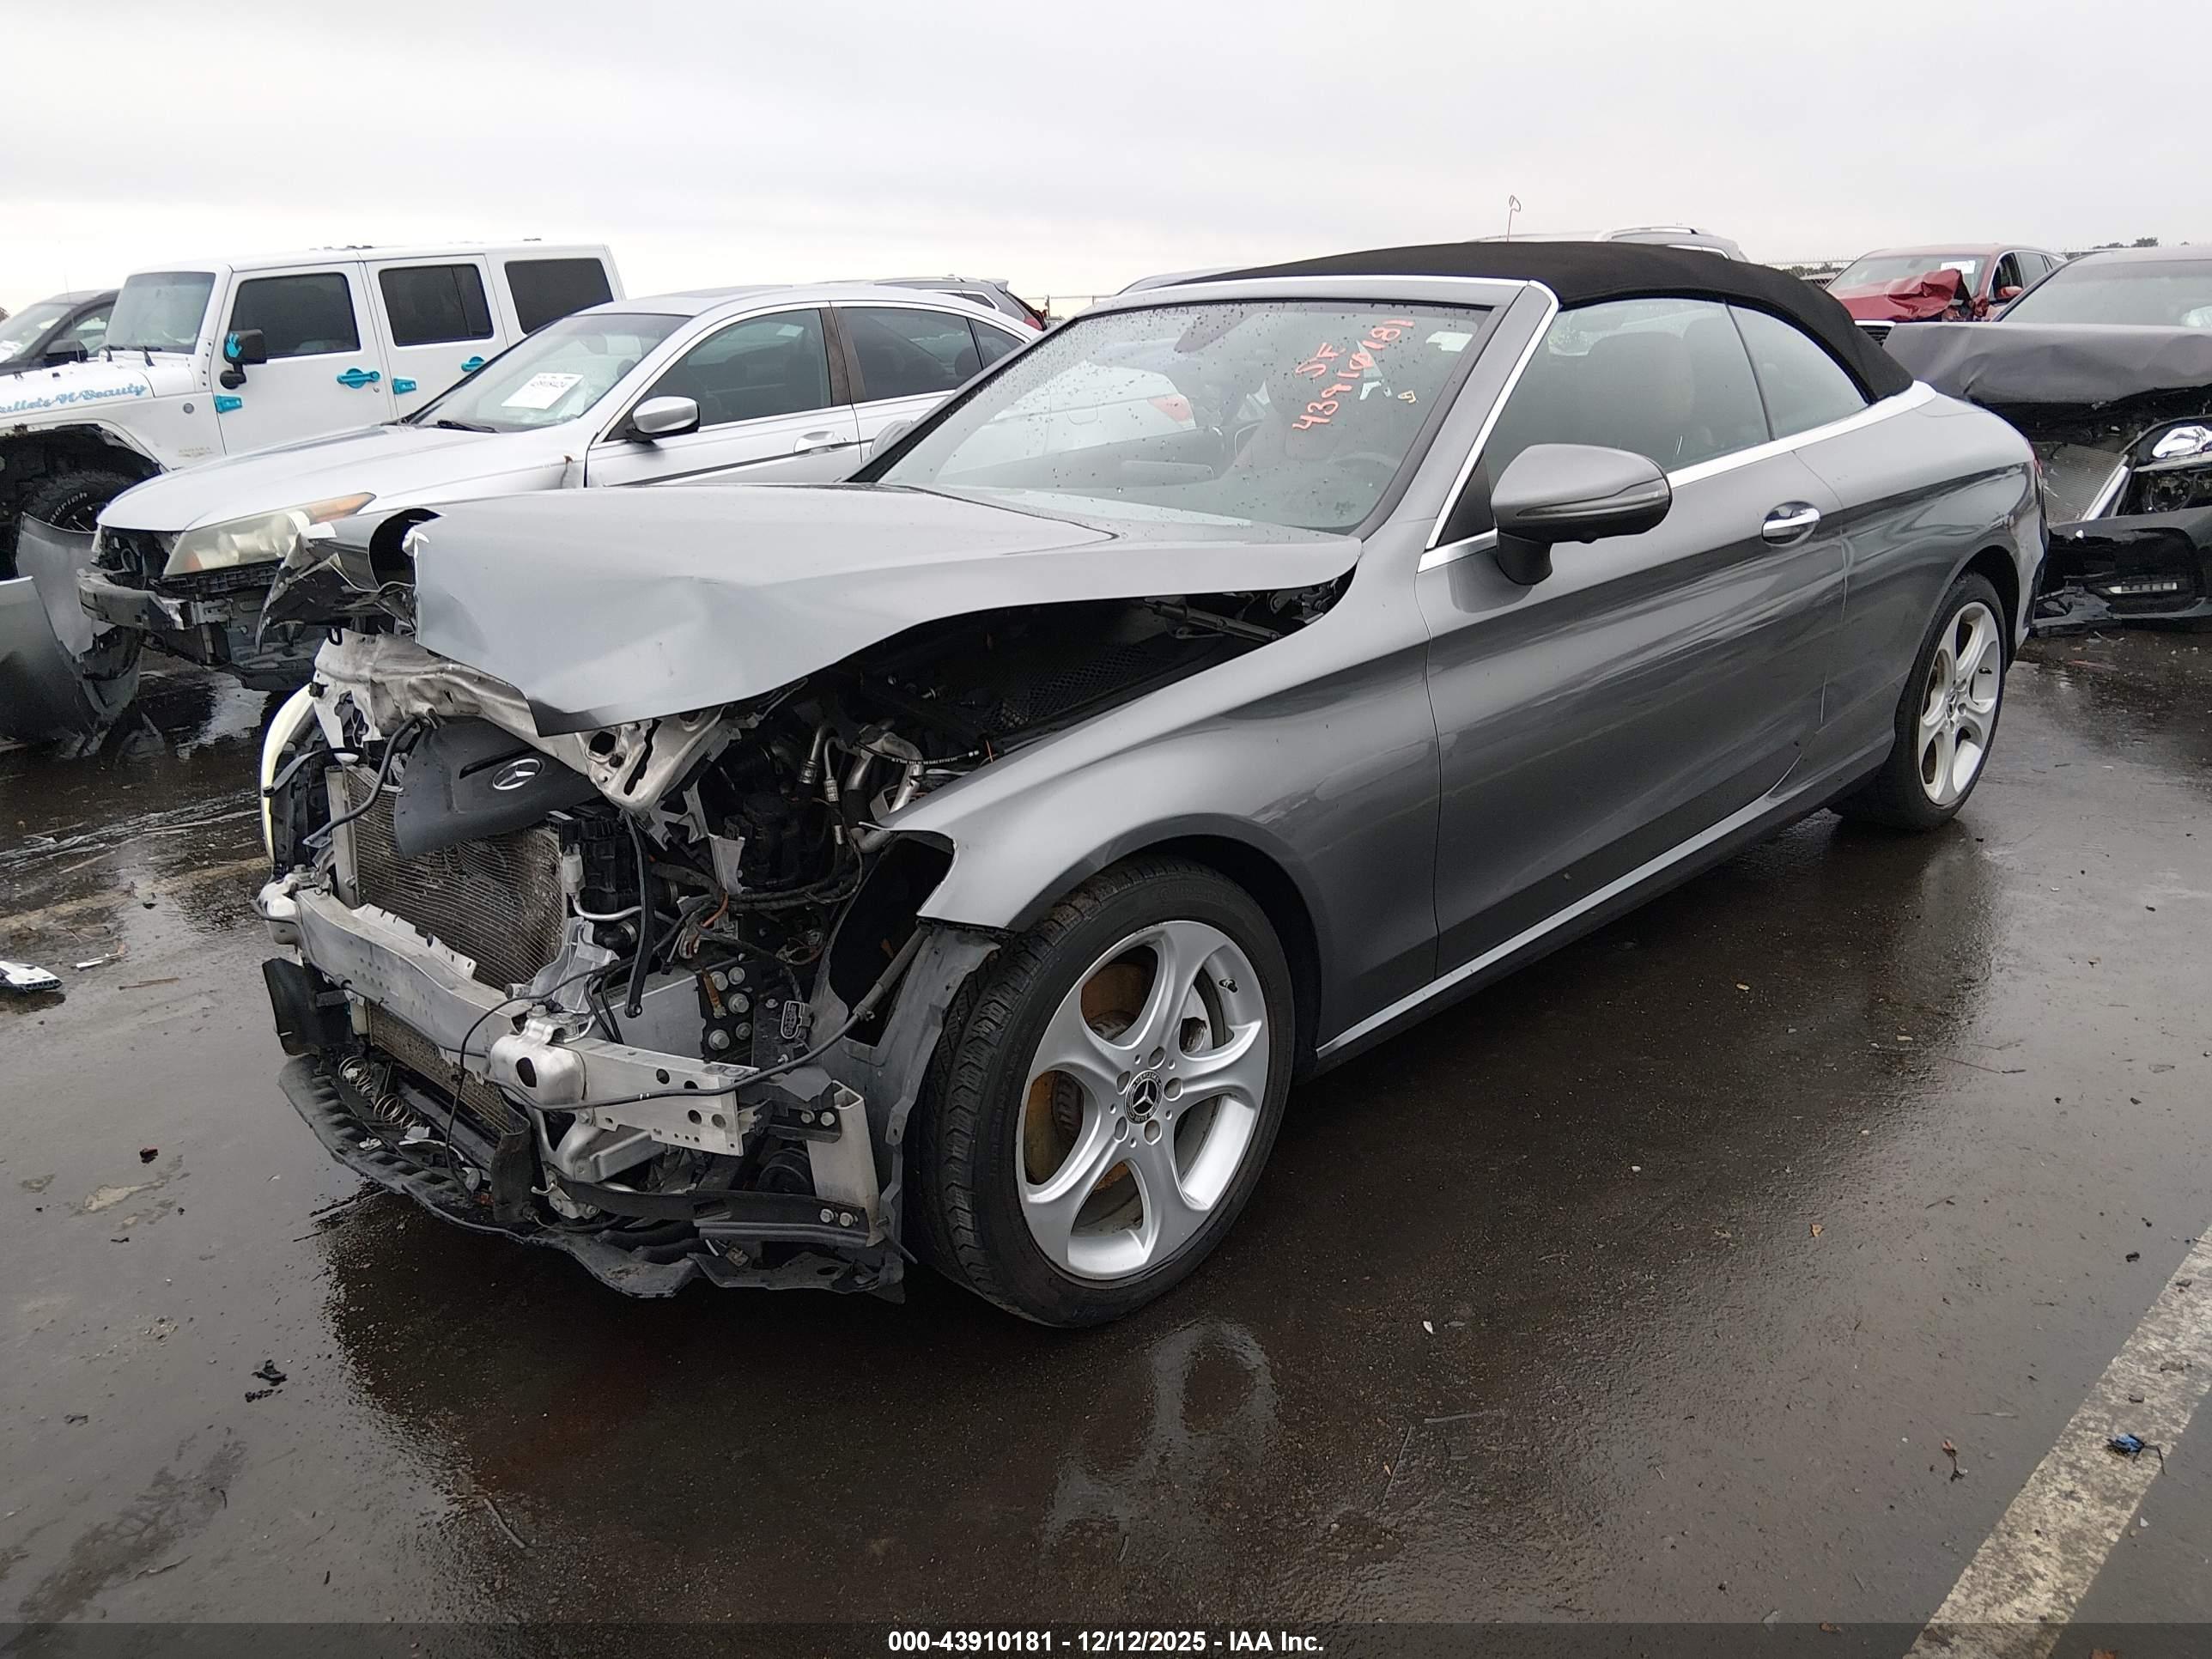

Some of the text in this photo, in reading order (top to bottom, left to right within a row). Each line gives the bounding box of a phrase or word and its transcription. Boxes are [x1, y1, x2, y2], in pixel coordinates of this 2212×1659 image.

[0, 398, 52, 414] ullets
[79, 383, 146, 401] Beauty
[1291, 319, 1415, 430] 43910181
